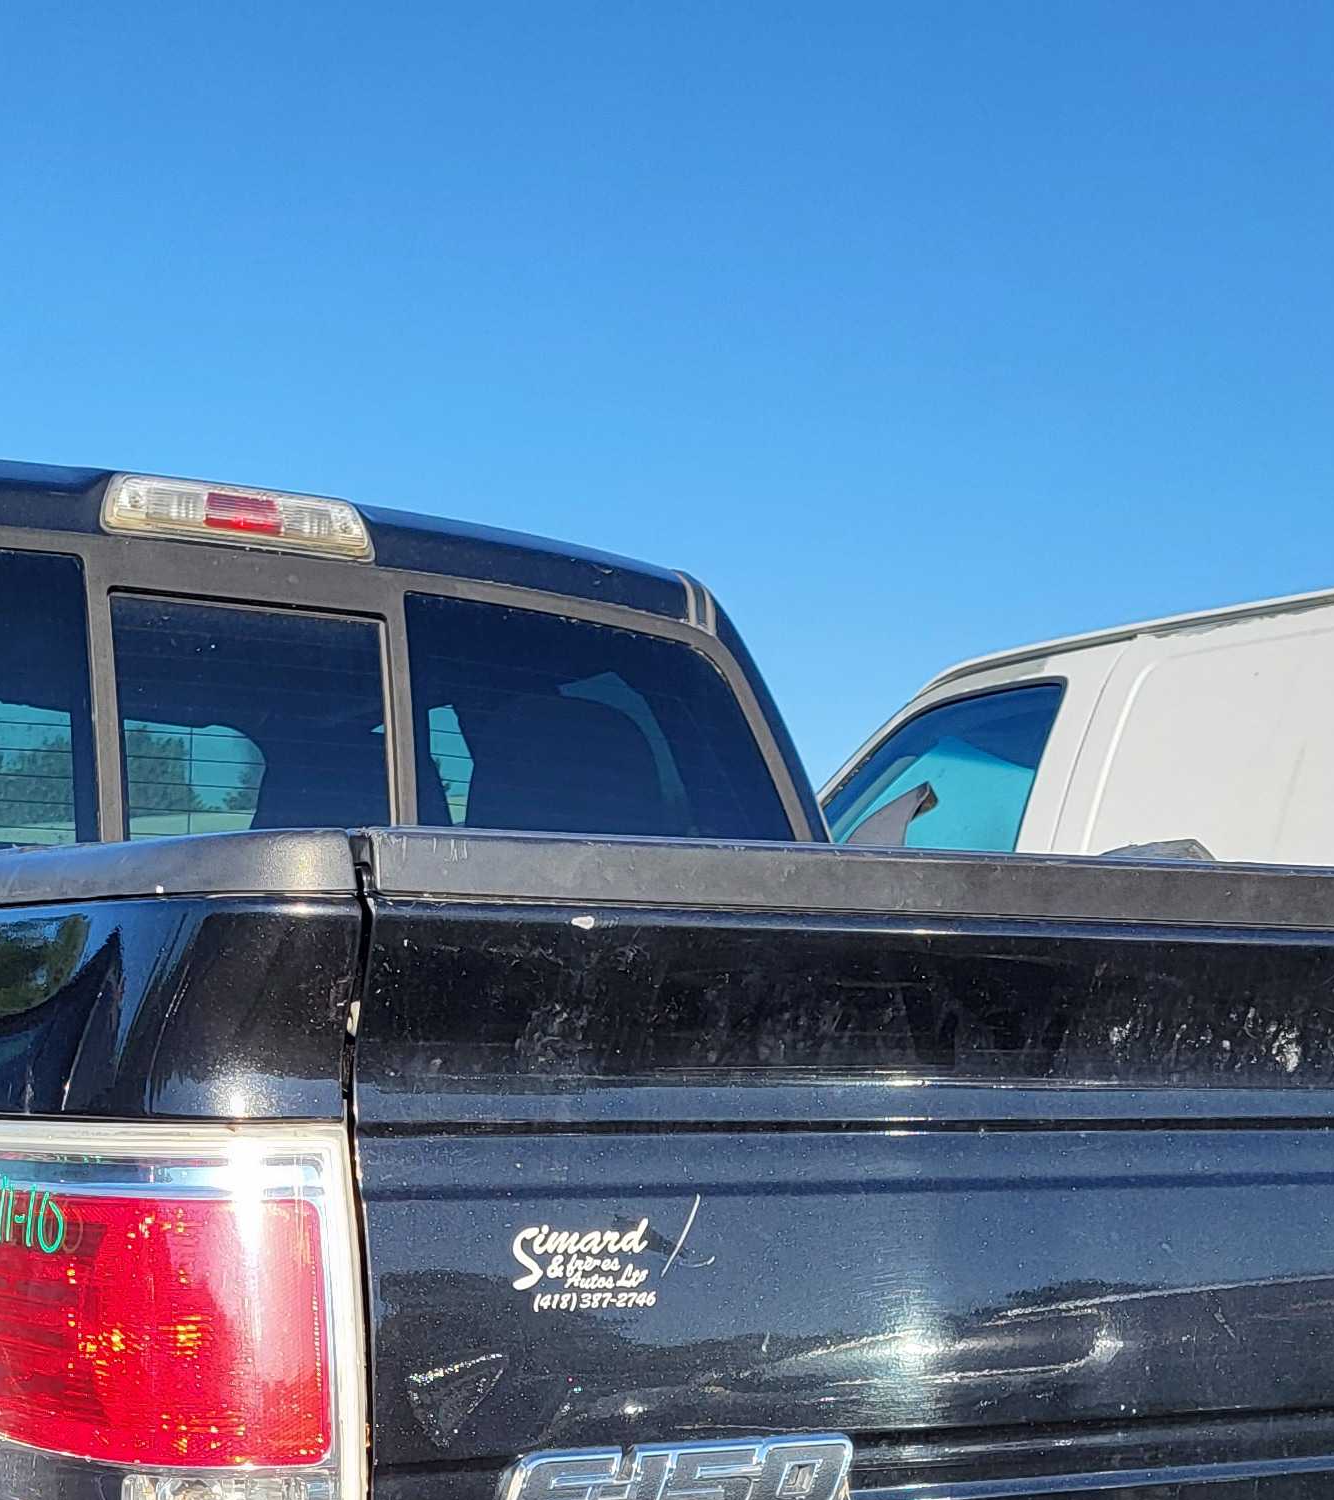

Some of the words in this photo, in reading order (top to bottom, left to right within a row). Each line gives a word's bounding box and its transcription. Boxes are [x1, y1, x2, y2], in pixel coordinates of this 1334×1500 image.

[512, 1217, 649, 1291] Simard
[547, 1255, 565, 1279] &
[564, 1273, 616, 1289] Autos
[533, 1293, 578, 1313] (418)
[579, 1291, 657, 1309] 387-2746
